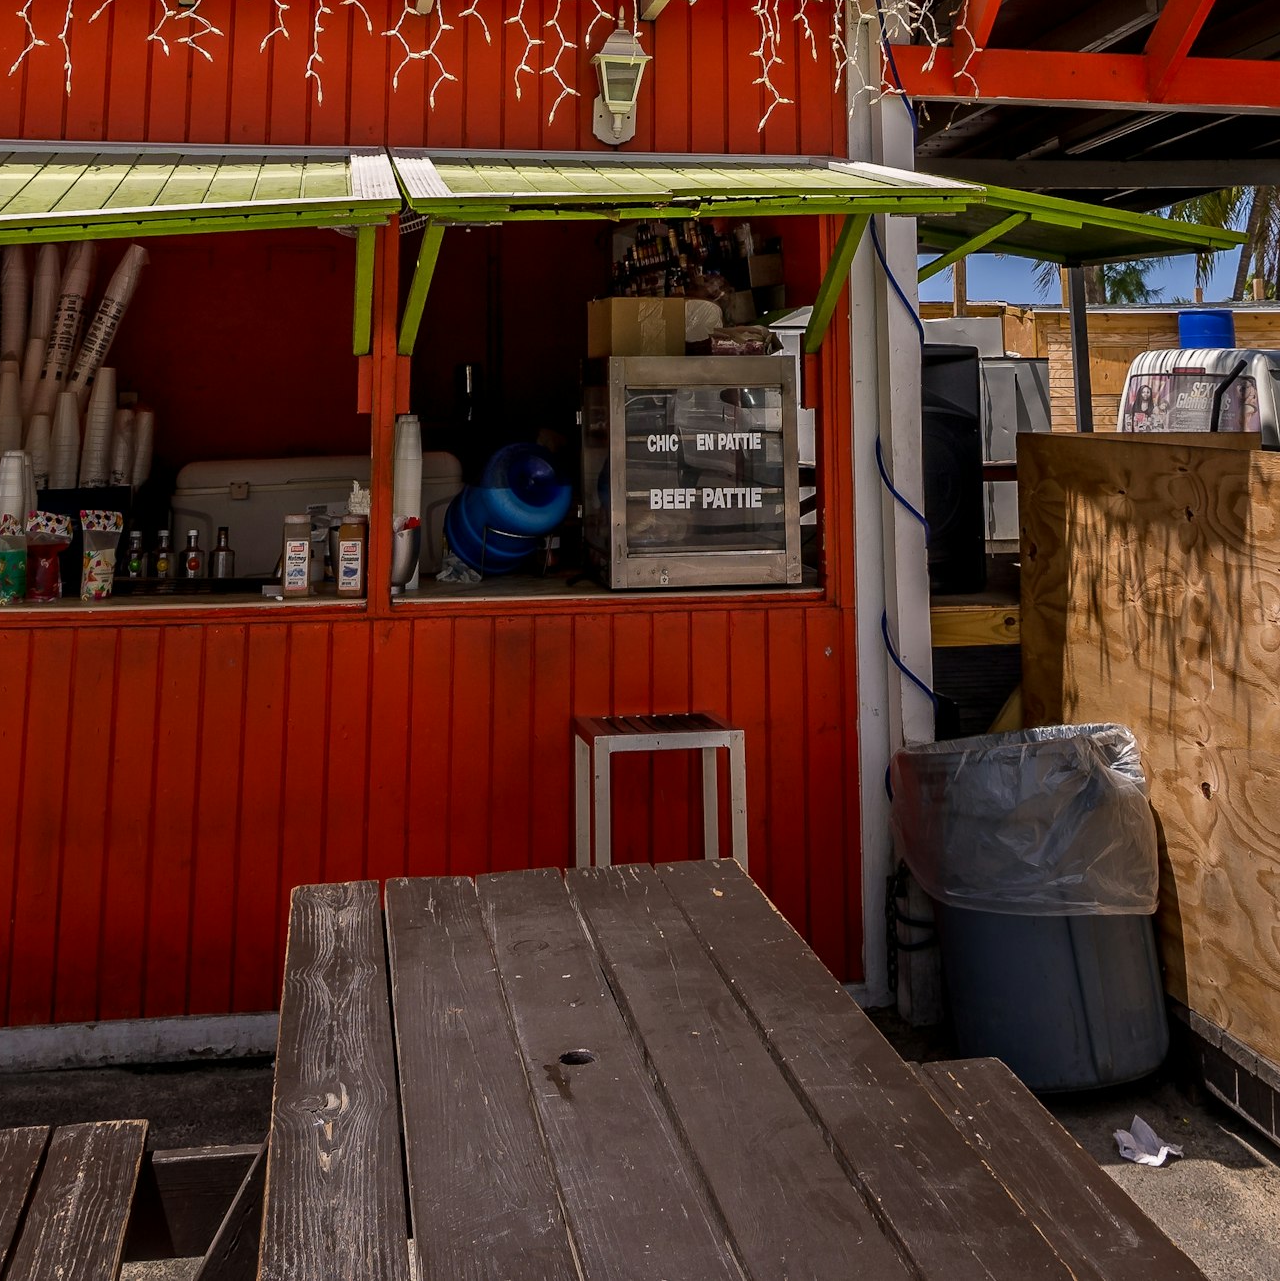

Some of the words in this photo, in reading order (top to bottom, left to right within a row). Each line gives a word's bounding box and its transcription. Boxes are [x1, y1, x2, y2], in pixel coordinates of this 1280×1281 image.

[717, 432, 762, 451] PATTIE
[649, 488, 696, 510] BEEF
[701, 487, 762, 509] PATTIE
